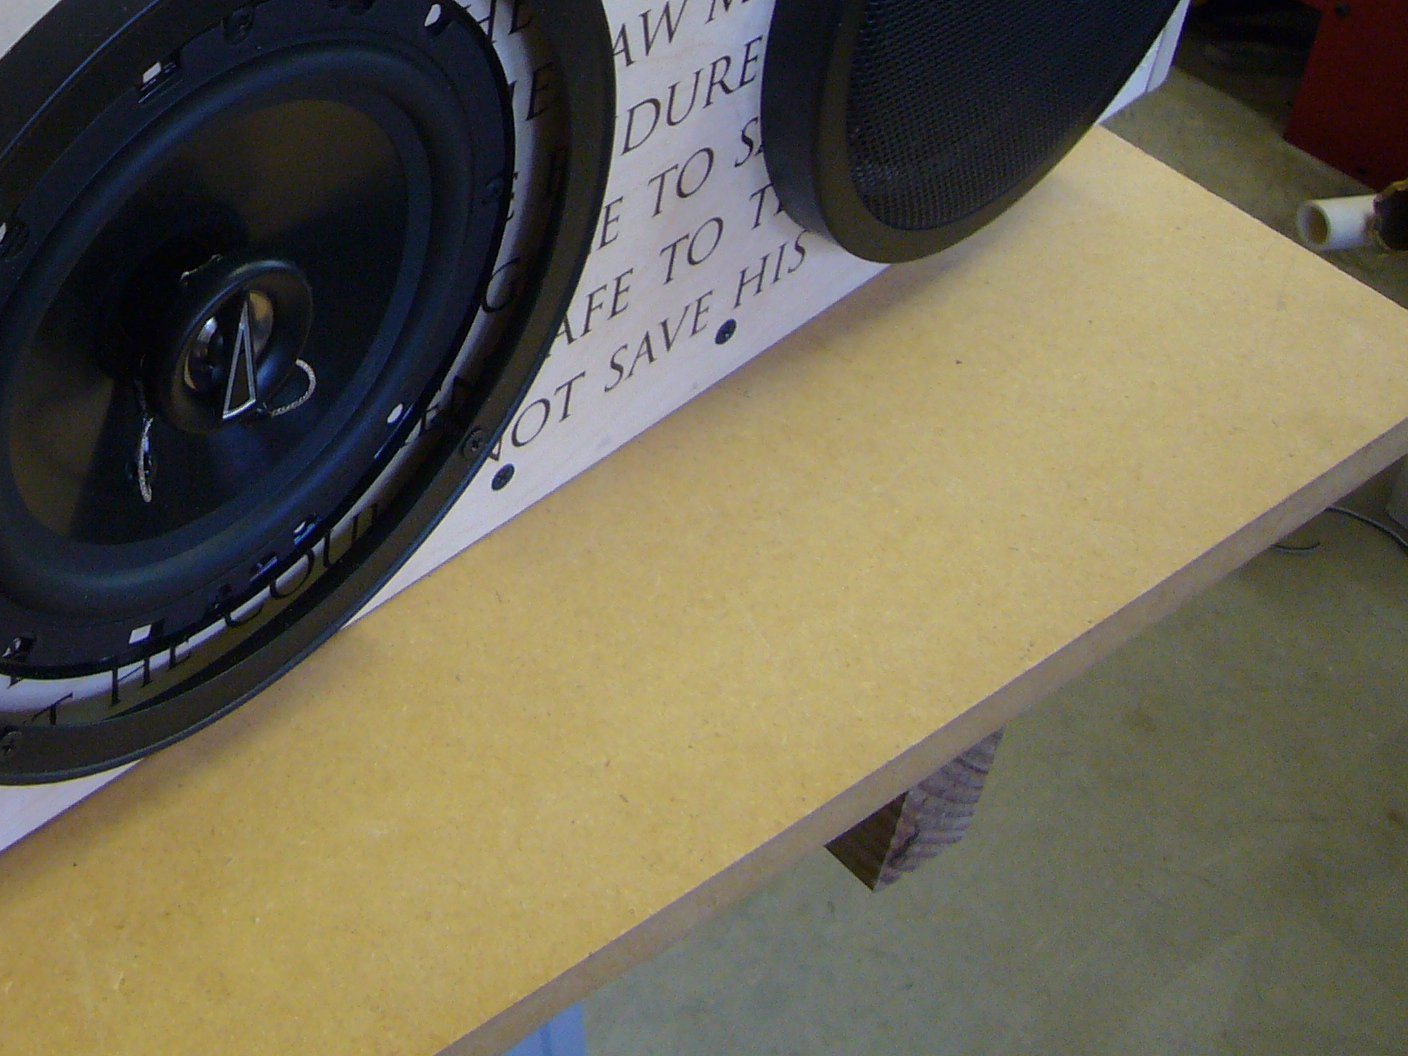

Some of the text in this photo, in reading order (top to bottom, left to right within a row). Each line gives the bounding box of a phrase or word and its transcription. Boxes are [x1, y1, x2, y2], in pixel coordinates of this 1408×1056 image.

[648, 147, 715, 218] TO
[660, 216, 725, 286] TO
[604, 290, 714, 393] SAVE
[733, 229, 812, 311] HIS
